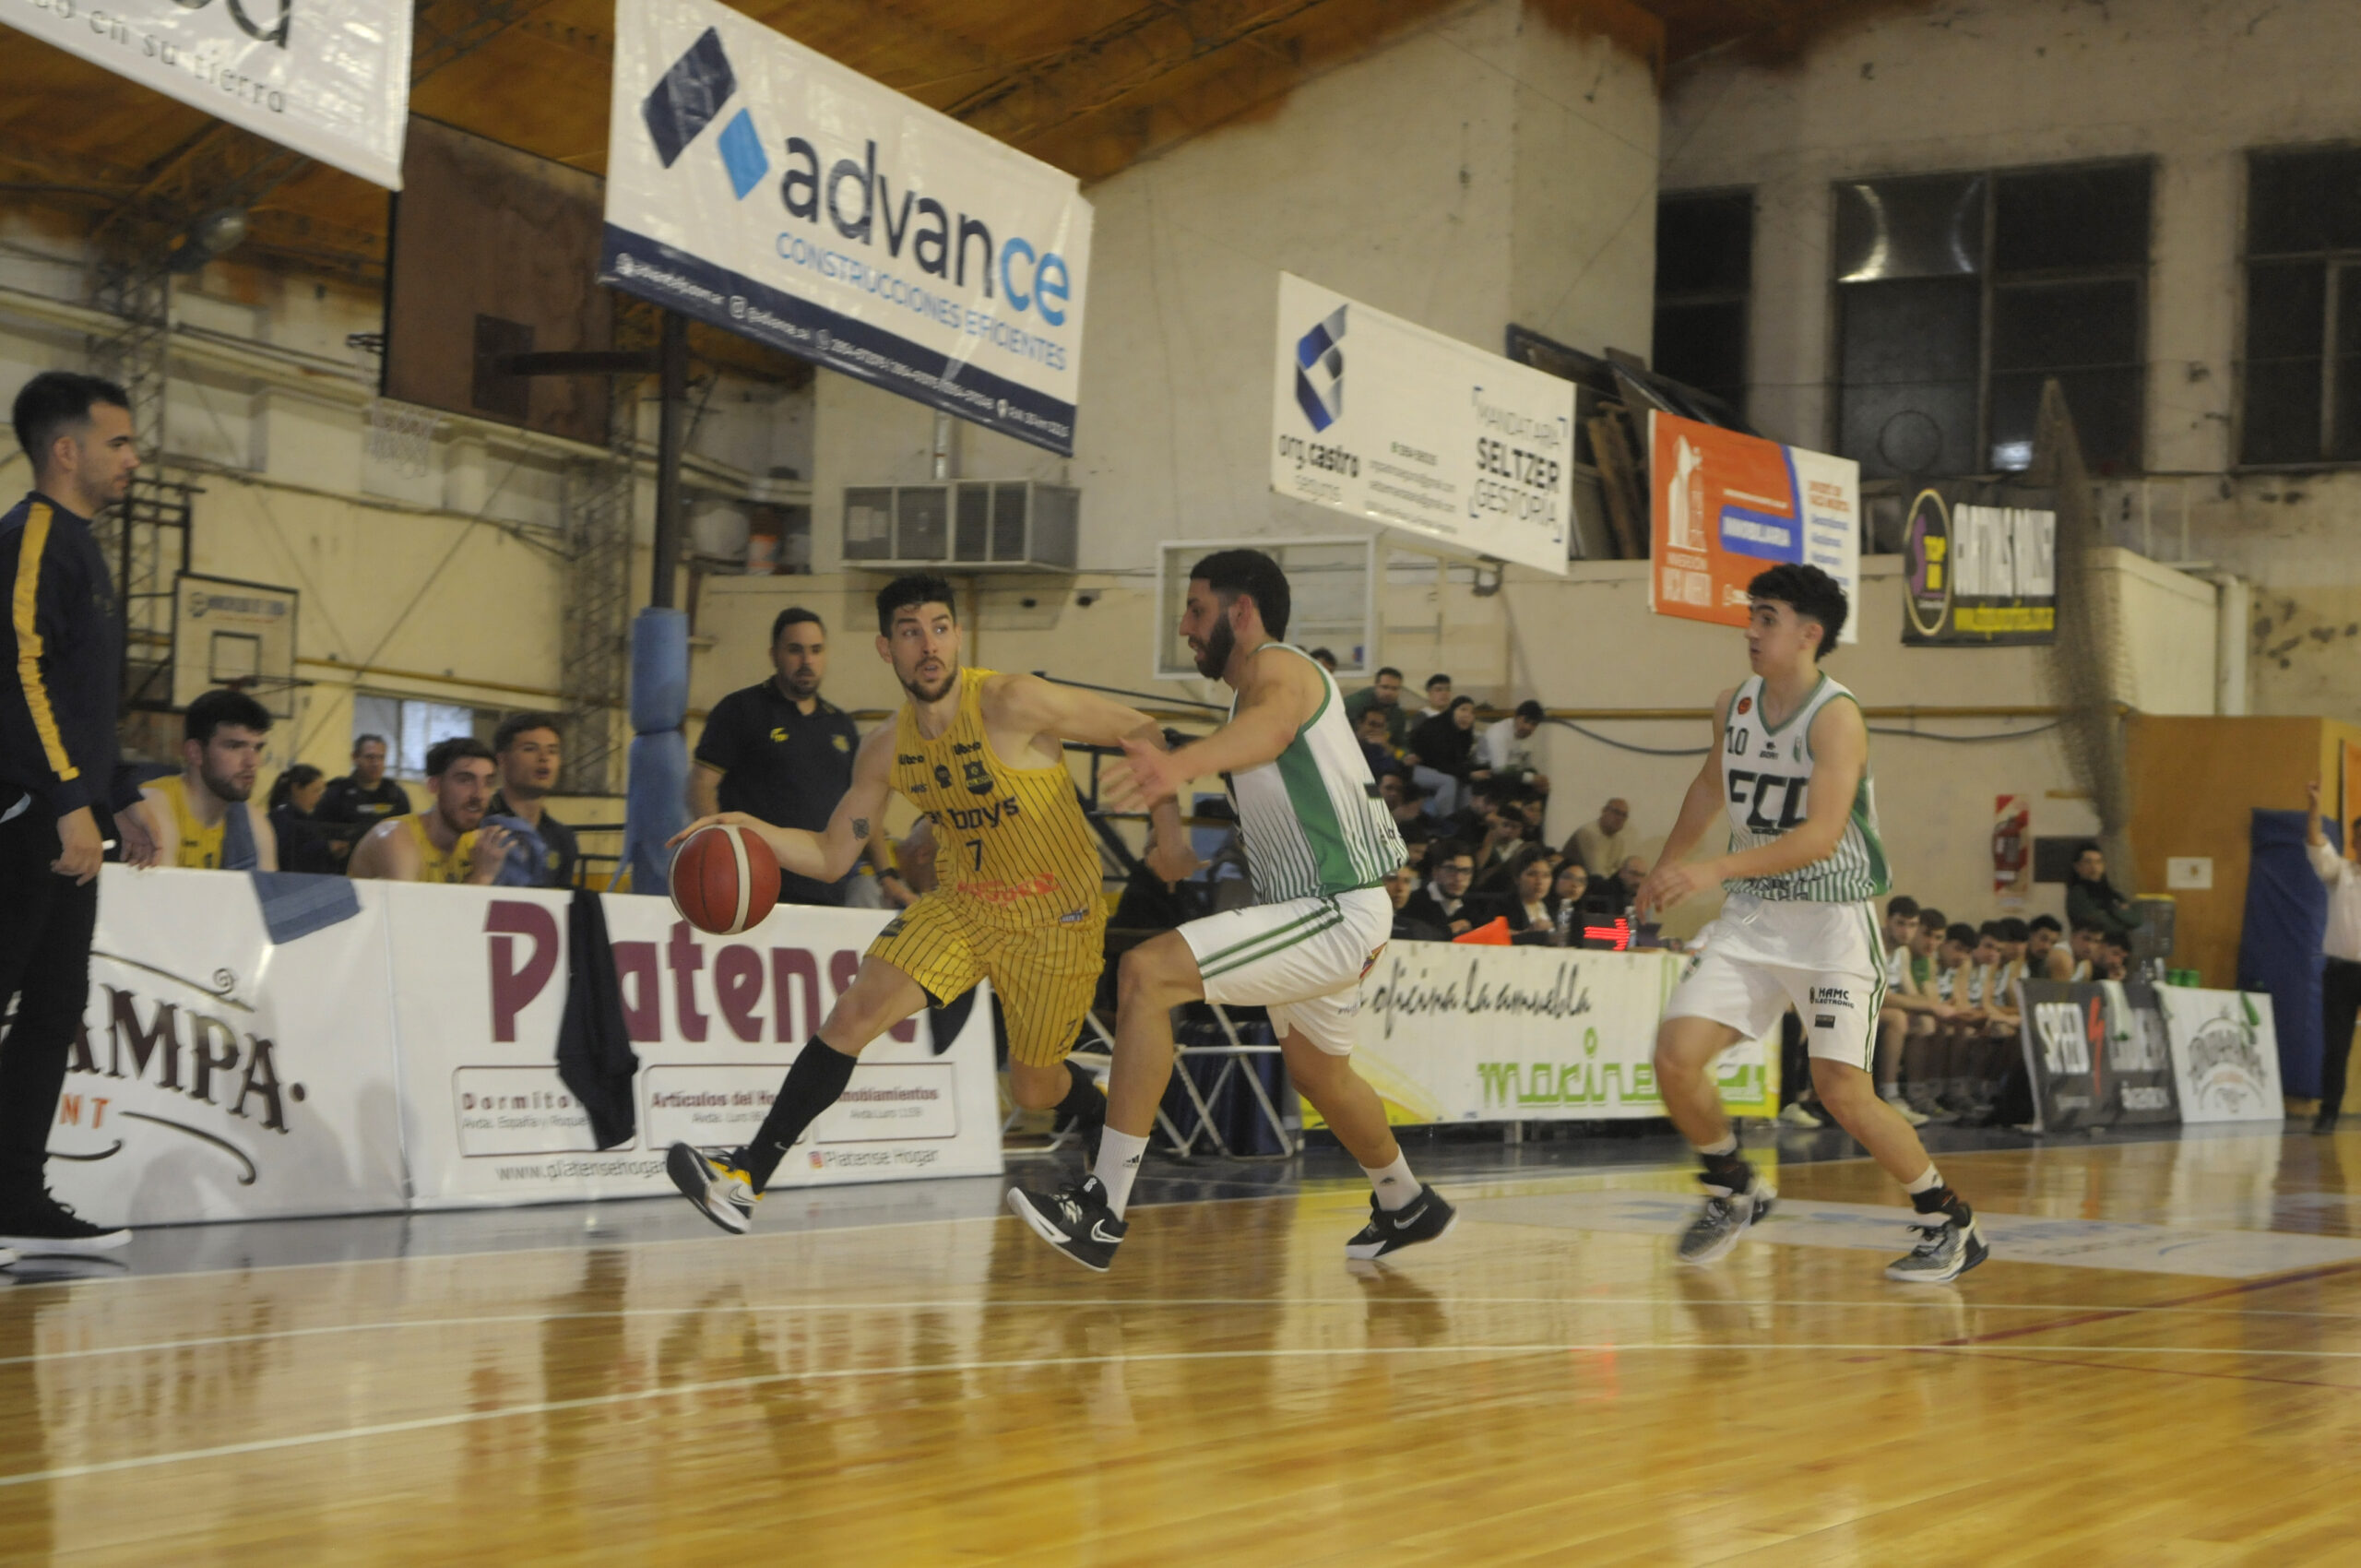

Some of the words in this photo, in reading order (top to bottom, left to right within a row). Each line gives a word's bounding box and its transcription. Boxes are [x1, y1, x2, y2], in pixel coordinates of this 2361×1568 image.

[780, 137, 1071, 327] advance
[776, 232, 961, 329] CONSTRUCCIONES
[965, 309, 1066, 371] EFICIENTES
[1476, 436, 1560, 493] SELTZER
[1726, 726, 1750, 755] 10
[946, 796, 1020, 830] boys
[966, 839, 983, 872] 7
[462, 1091, 585, 1111] Dormito
